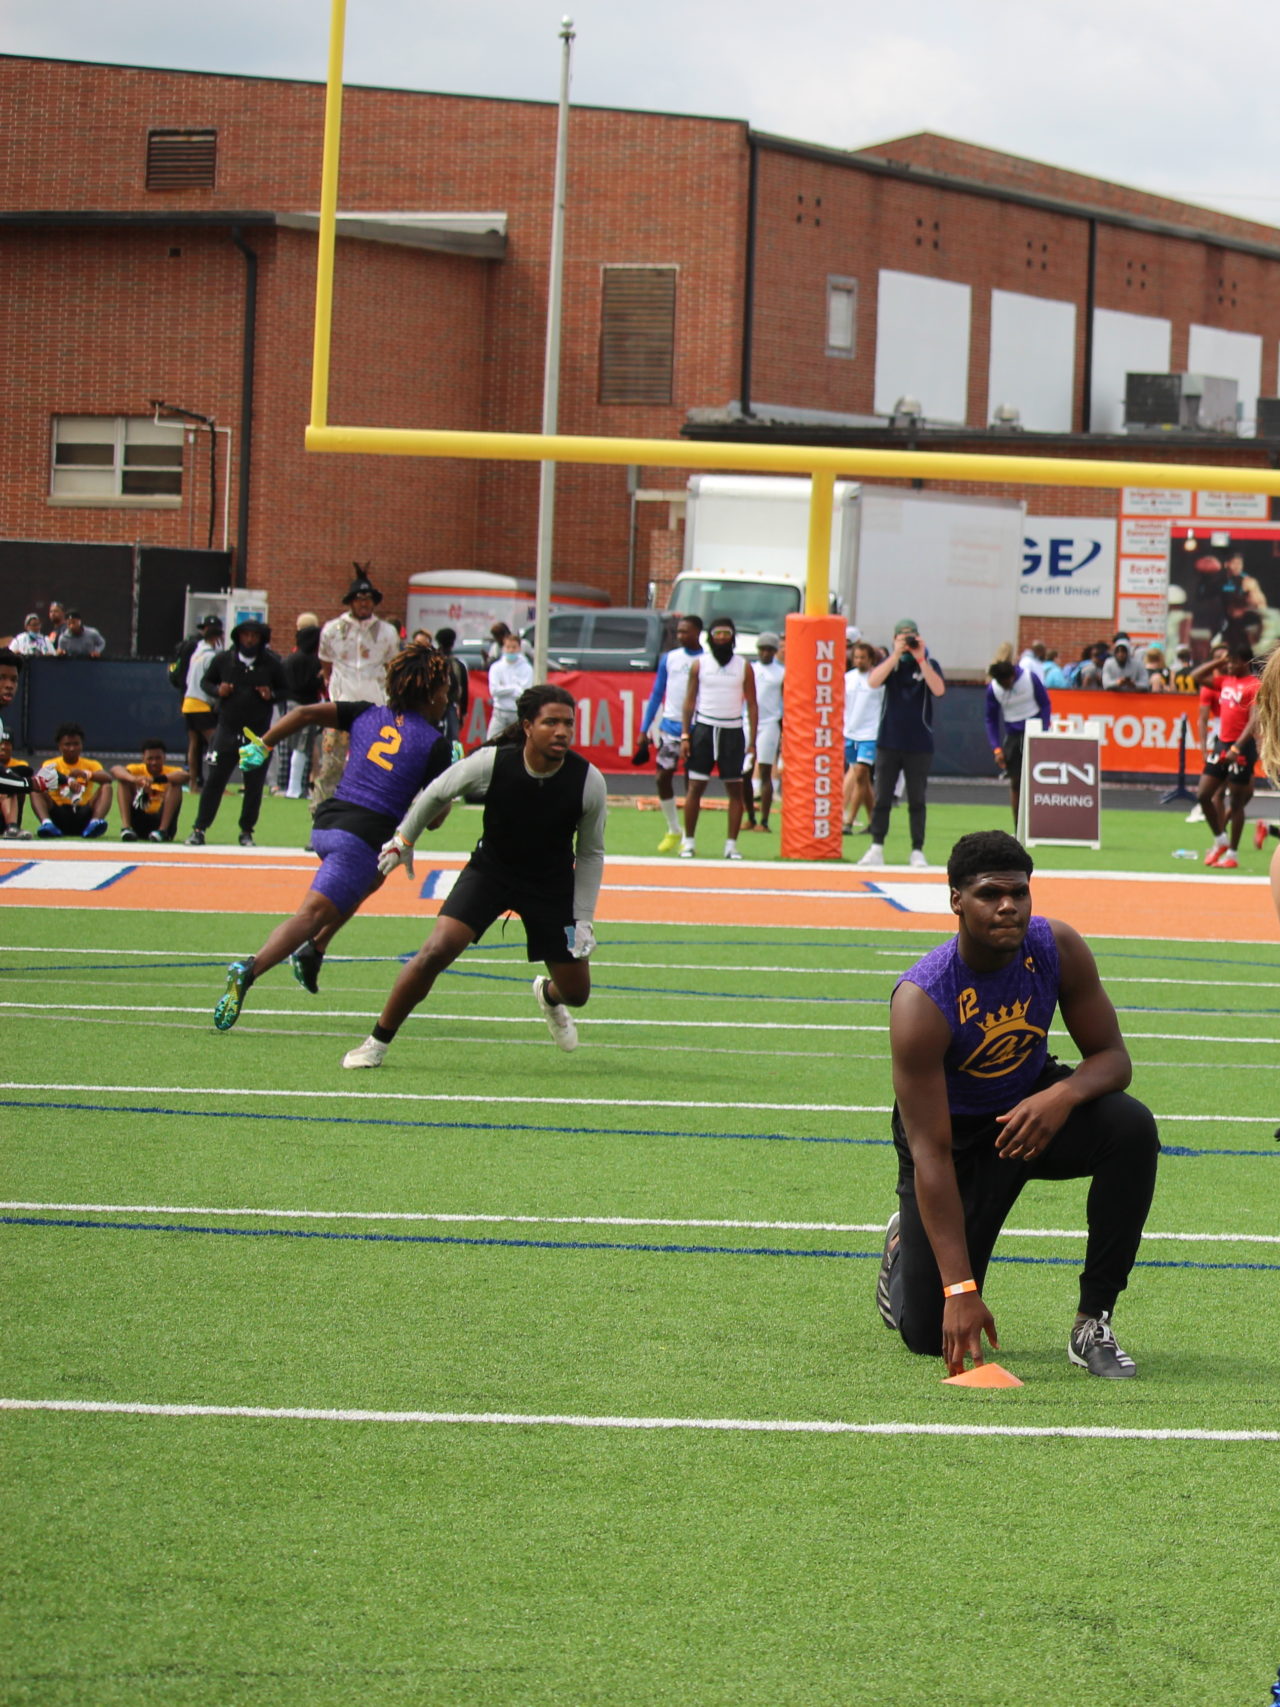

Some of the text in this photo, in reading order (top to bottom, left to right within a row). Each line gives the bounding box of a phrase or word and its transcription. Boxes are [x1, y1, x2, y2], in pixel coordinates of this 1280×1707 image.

[1020, 585, 1100, 596] Credit Union
[816, 640, 835, 748] NORTH
[366, 725, 402, 772] 2
[813, 754, 831, 839] COBB
[1034, 793, 1094, 808] PARKING
[956, 987, 980, 1025] 12
